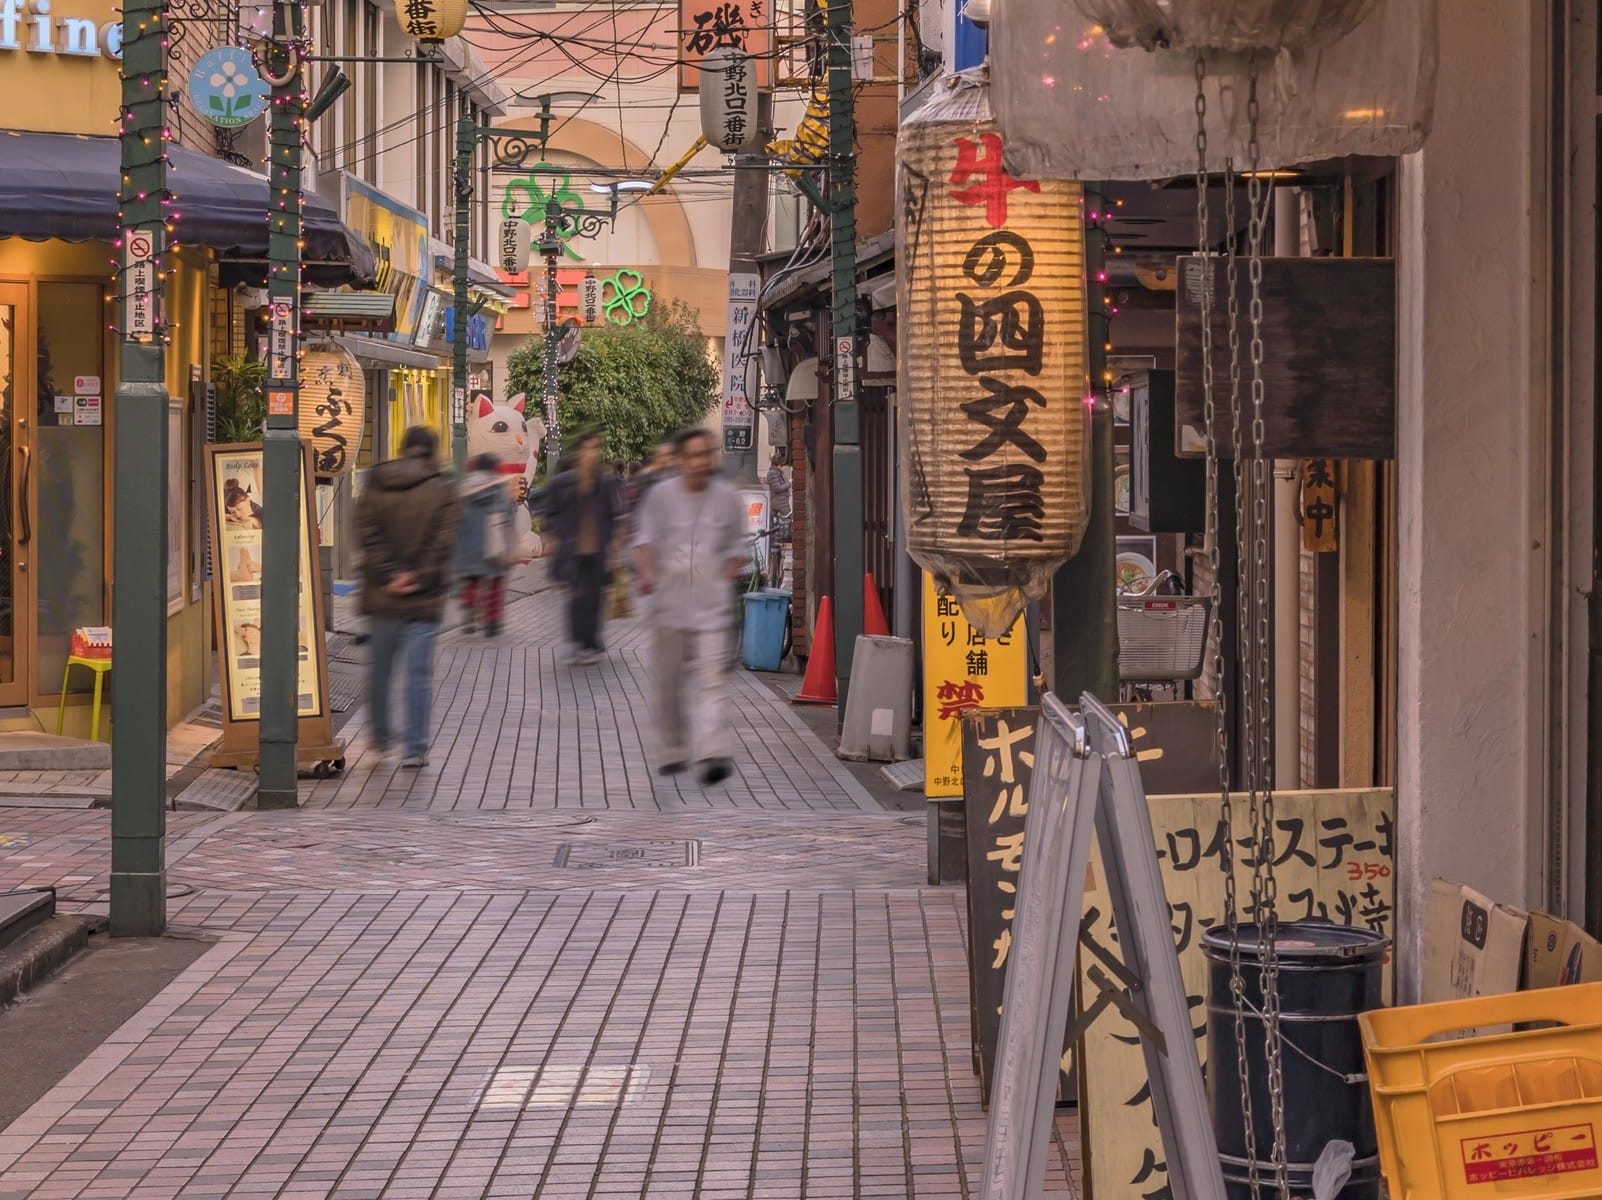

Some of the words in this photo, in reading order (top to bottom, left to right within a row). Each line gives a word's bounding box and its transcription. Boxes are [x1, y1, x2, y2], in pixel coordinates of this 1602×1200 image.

[722, 50, 748, 148] 中野北口一番街
[503, 220, 518, 273] 中野北口一番街
[134, 260, 146, 328] 路上喫煙禁止地区
[730, 306, 750, 392] 新橋医院
[945, 134, 1051, 543] 牛の四文屋
[1154, 810, 1394, 874] ロインステーキ
[1346, 861, 1391, 882] 350
[1468, 1158, 1596, 1182] ホッピービバレッジ株式会社
[1470, 1131, 1587, 1161] ホッピー
